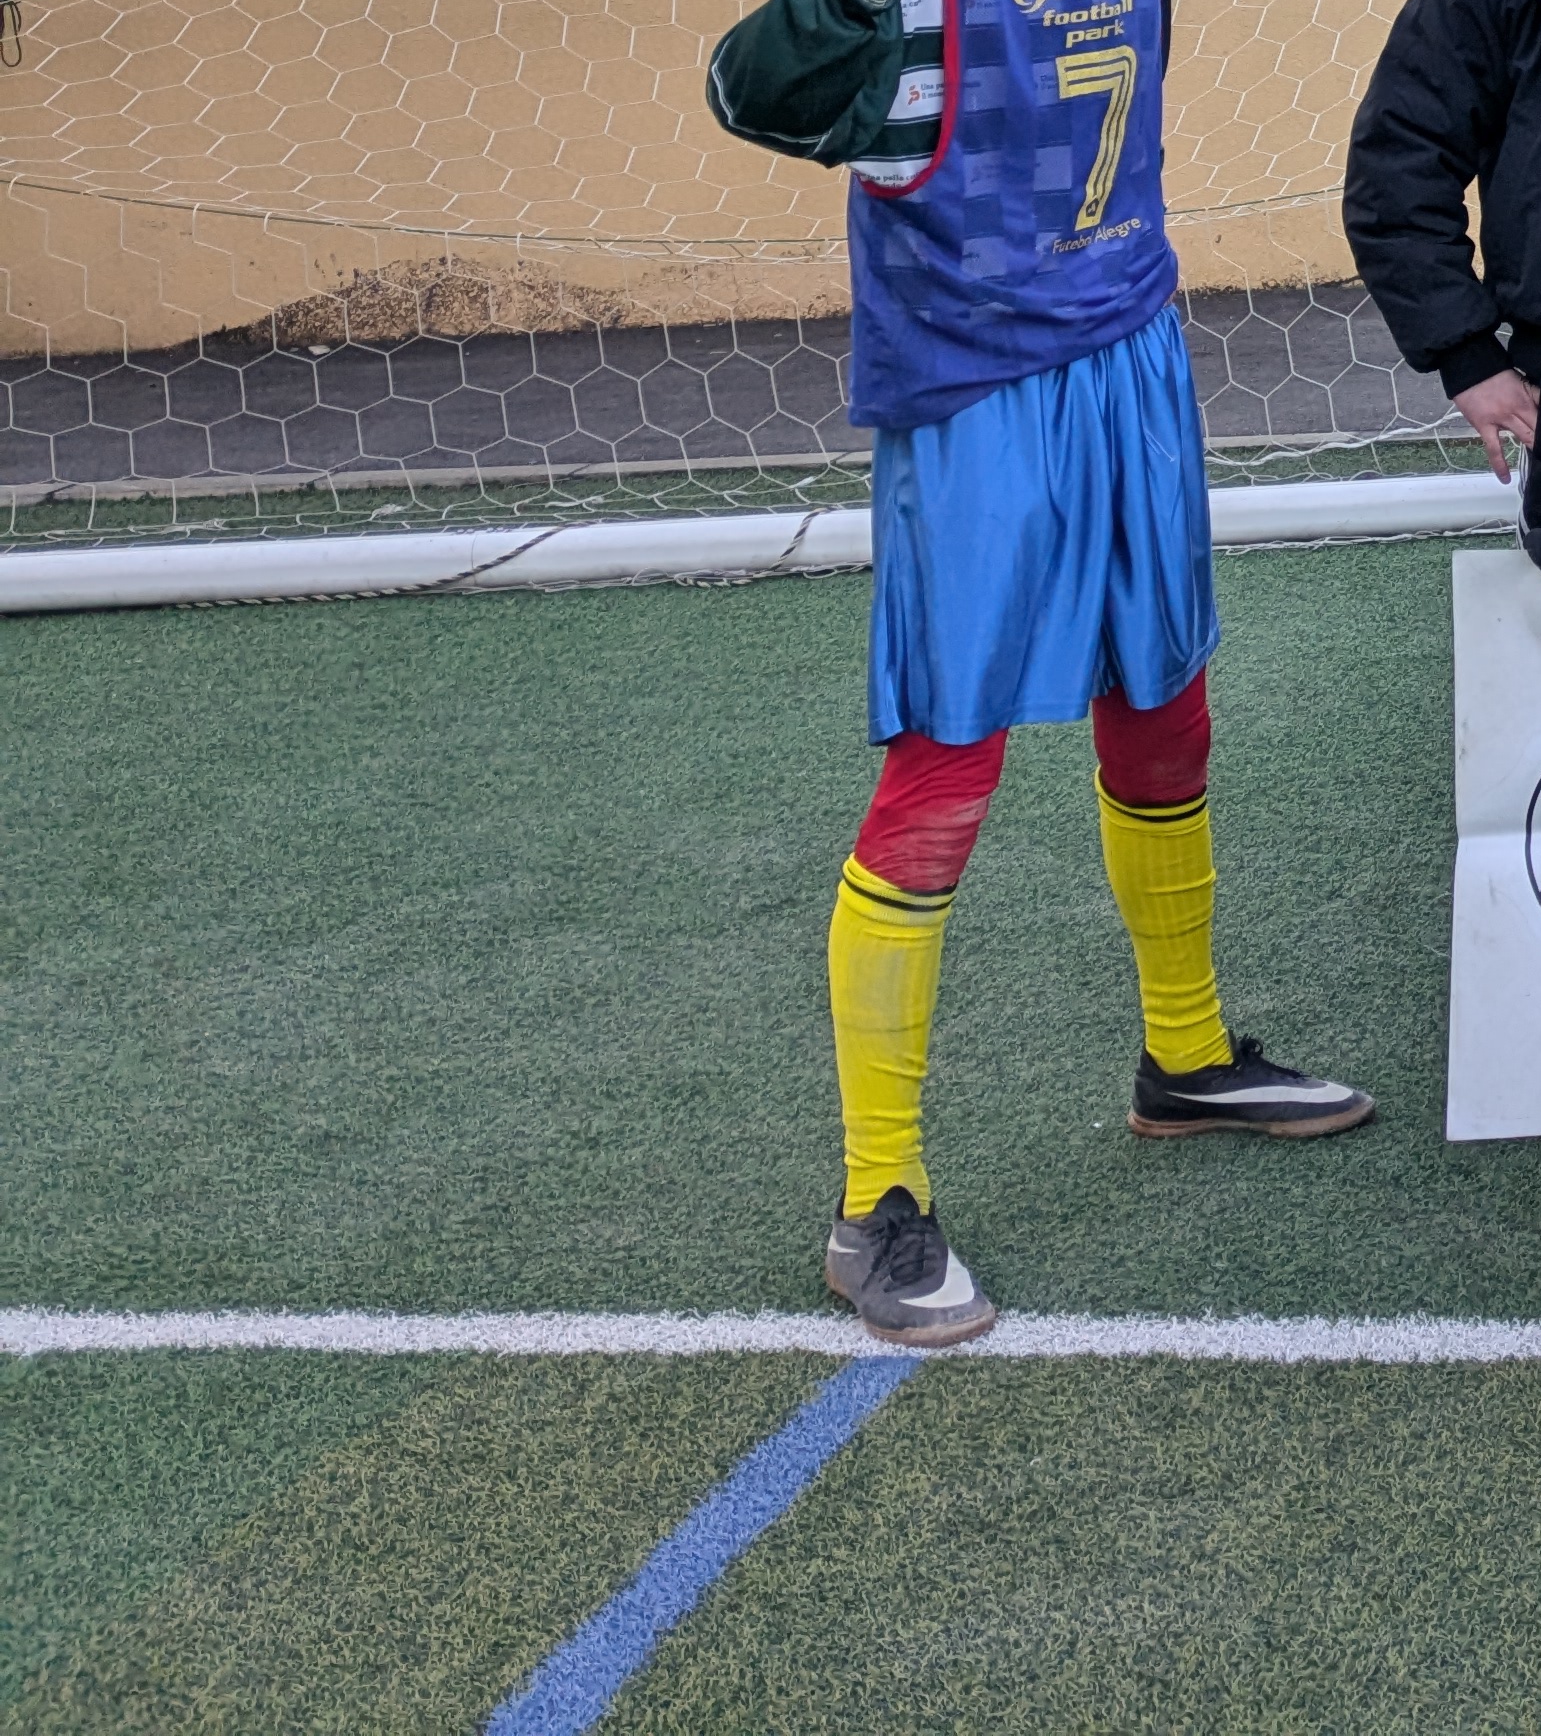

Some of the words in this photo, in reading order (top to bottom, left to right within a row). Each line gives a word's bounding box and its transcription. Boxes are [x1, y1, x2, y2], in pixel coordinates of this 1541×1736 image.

[1065, 19, 1125, 49] park
[1055, 45, 1137, 231] 7
[1094, 217, 1141, 244] Alegre
